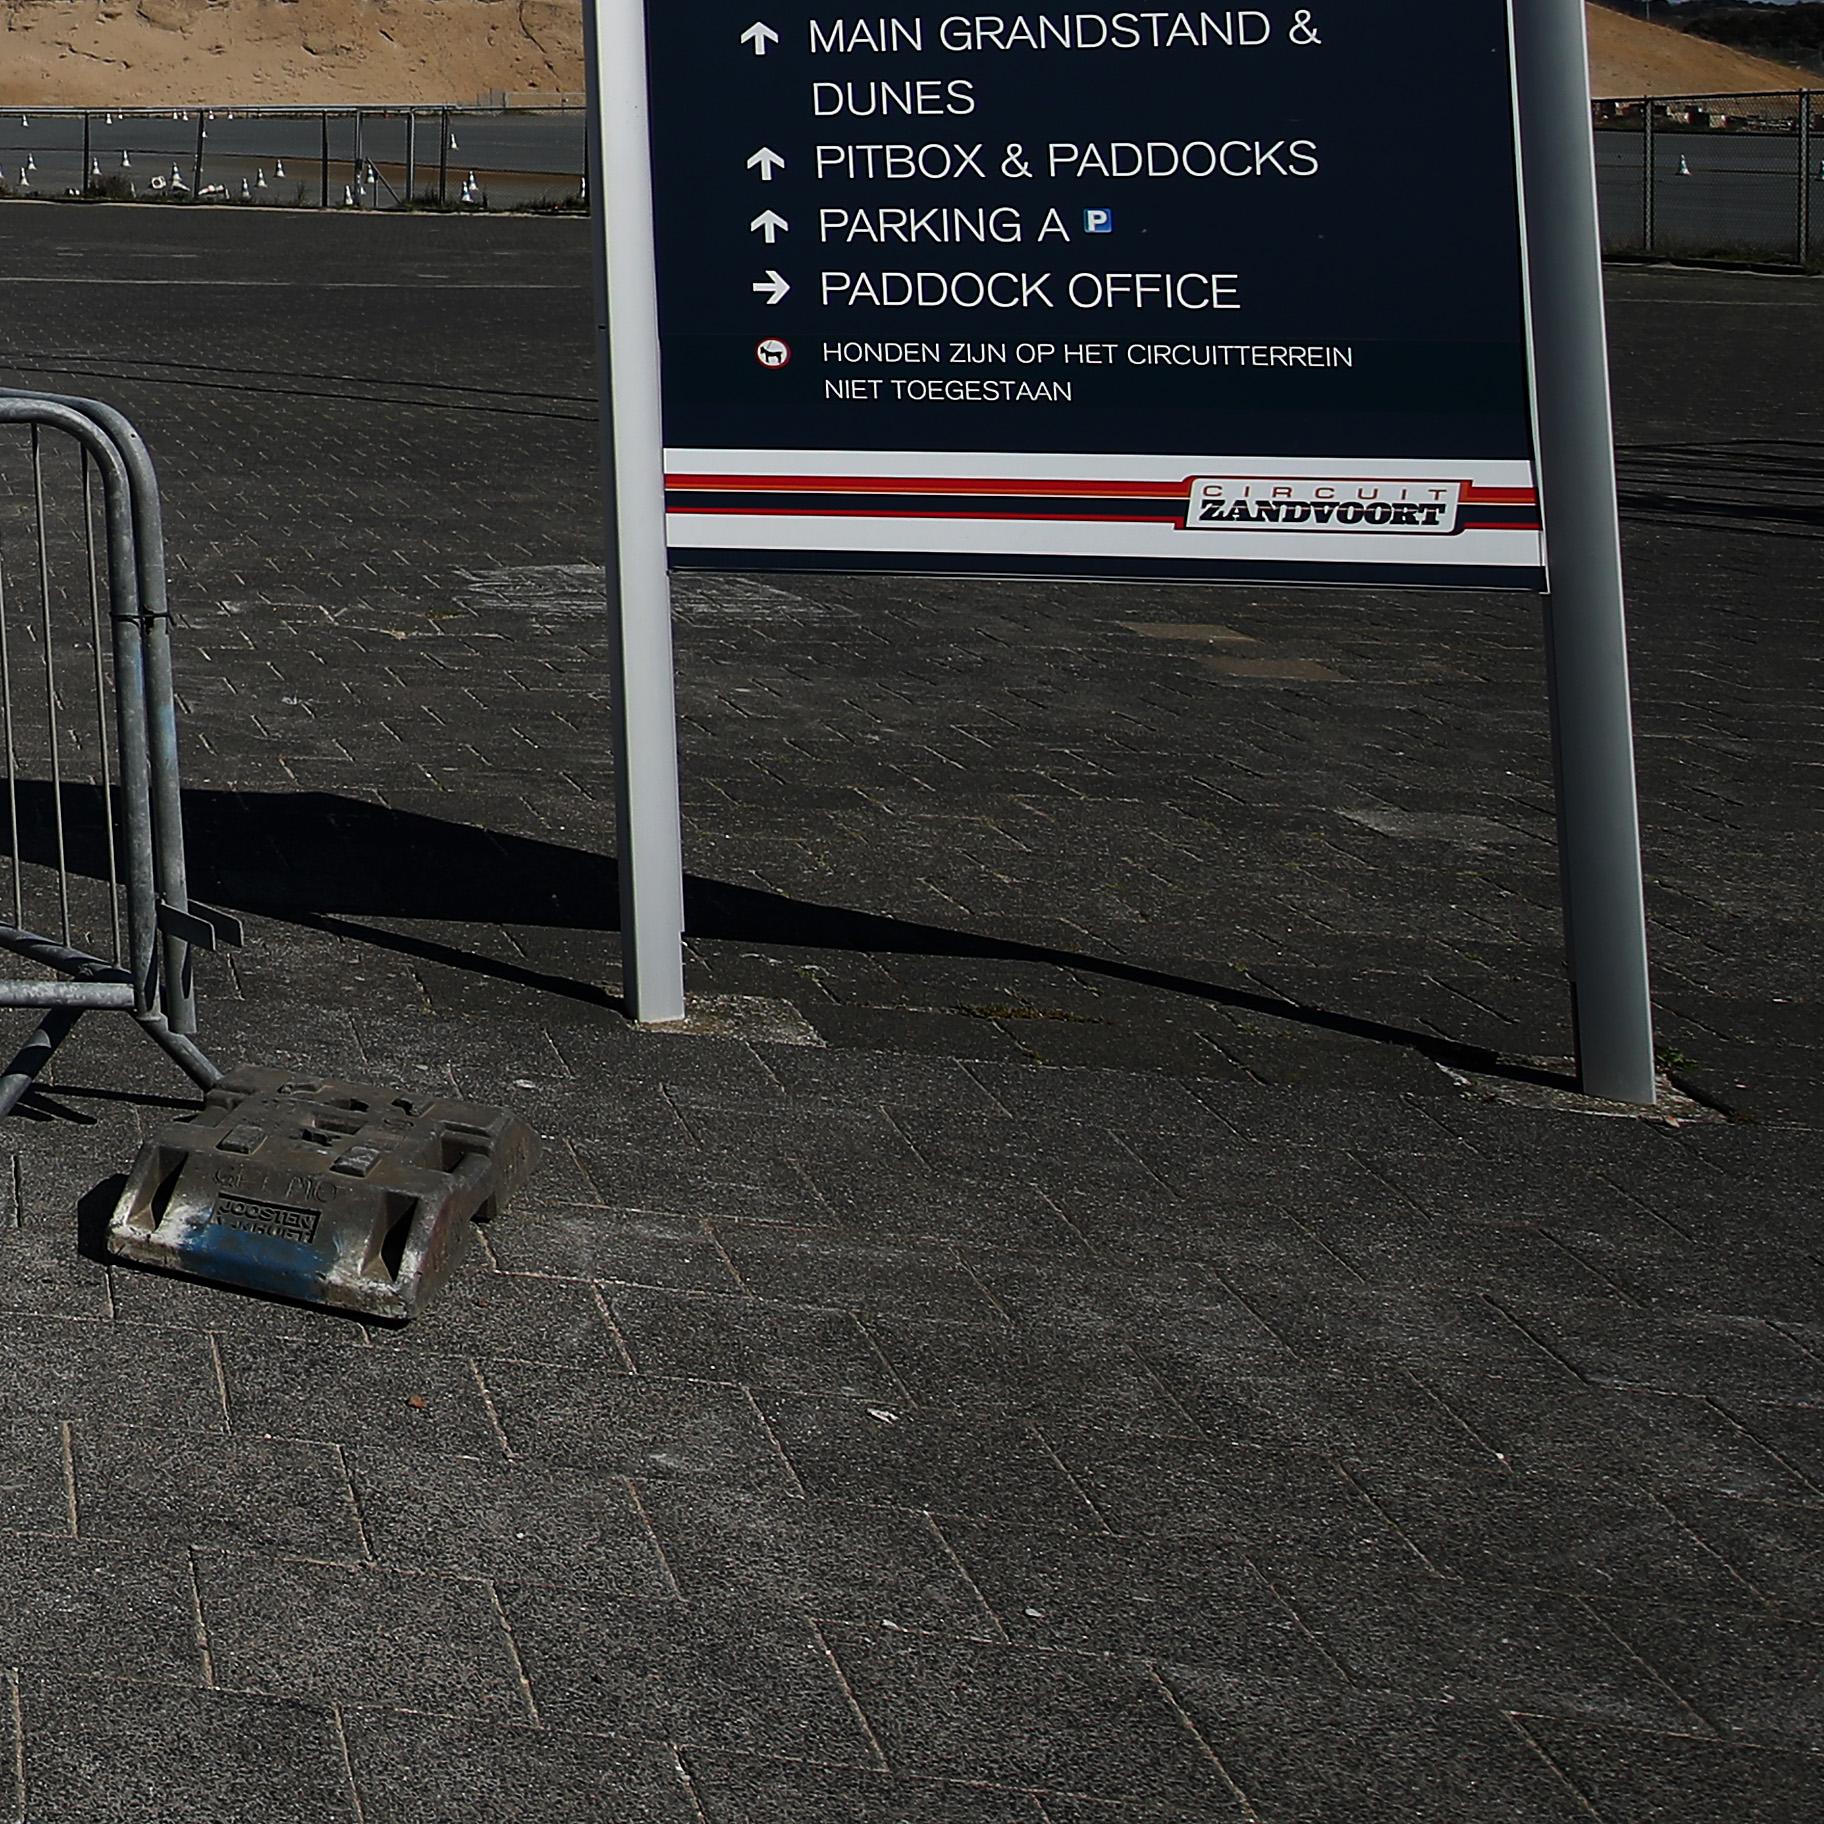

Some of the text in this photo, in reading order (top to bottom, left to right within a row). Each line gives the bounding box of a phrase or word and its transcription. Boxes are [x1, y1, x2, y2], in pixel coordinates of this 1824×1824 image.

[810, 10, 1321, 52] MAIN GRANDSTAND &
[813, 80, 974, 115] DUNES
[817, 140, 1318, 178] PITBOX & PADDOCKS
[820, 207, 1021, 242] PARKING
[1038, 208, 1070, 241] A
[822, 272, 1240, 308] PADDOCK OFFICE
[824, 342, 1352, 366] HONDEN ZIJN OP HET CIRCUITTERREIN
[826, 380, 1071, 401] NIET TOEGESTAAN
[1202, 484, 1447, 500] CIRCUIT
[1199, 499, 1446, 526] ZANDVOORT
